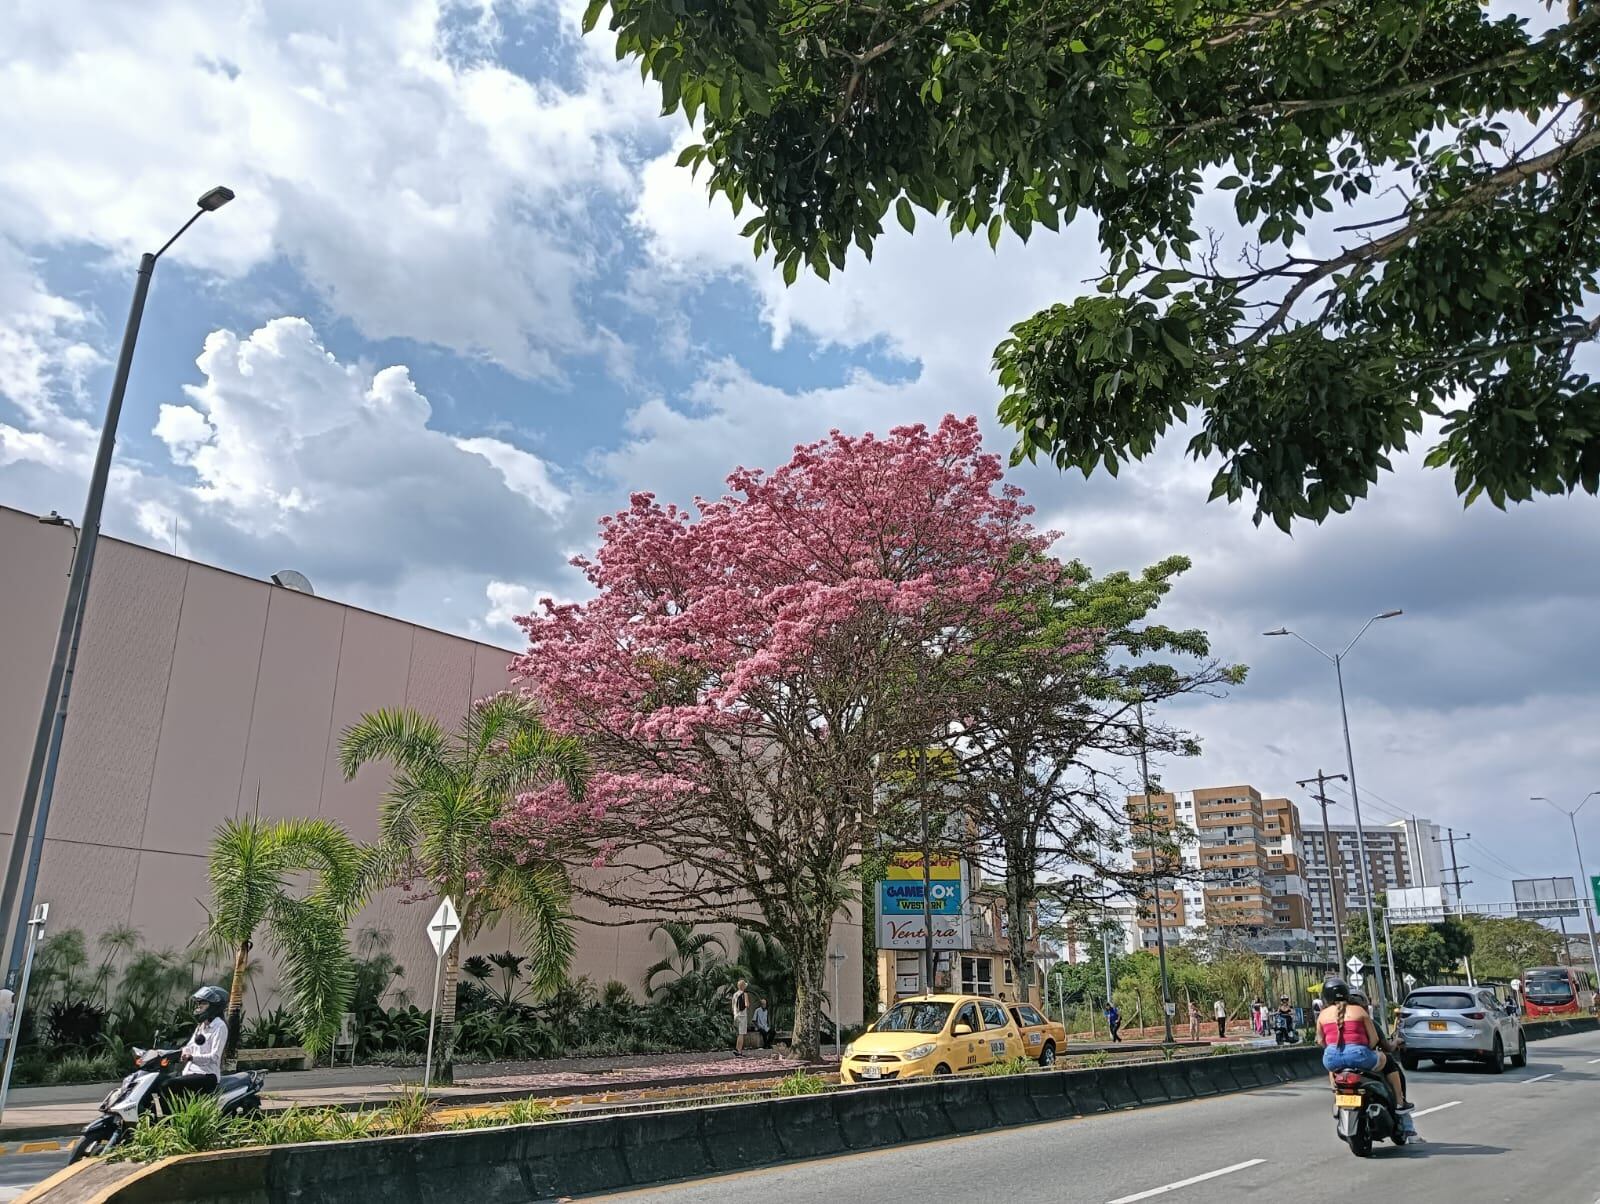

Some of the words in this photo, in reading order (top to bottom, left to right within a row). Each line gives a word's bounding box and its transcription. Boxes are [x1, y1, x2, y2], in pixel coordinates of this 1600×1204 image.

[887, 885, 955, 899] GAMEOX
[902, 901, 942, 910] WESTRN
[887, 920, 957, 940] Ventra
